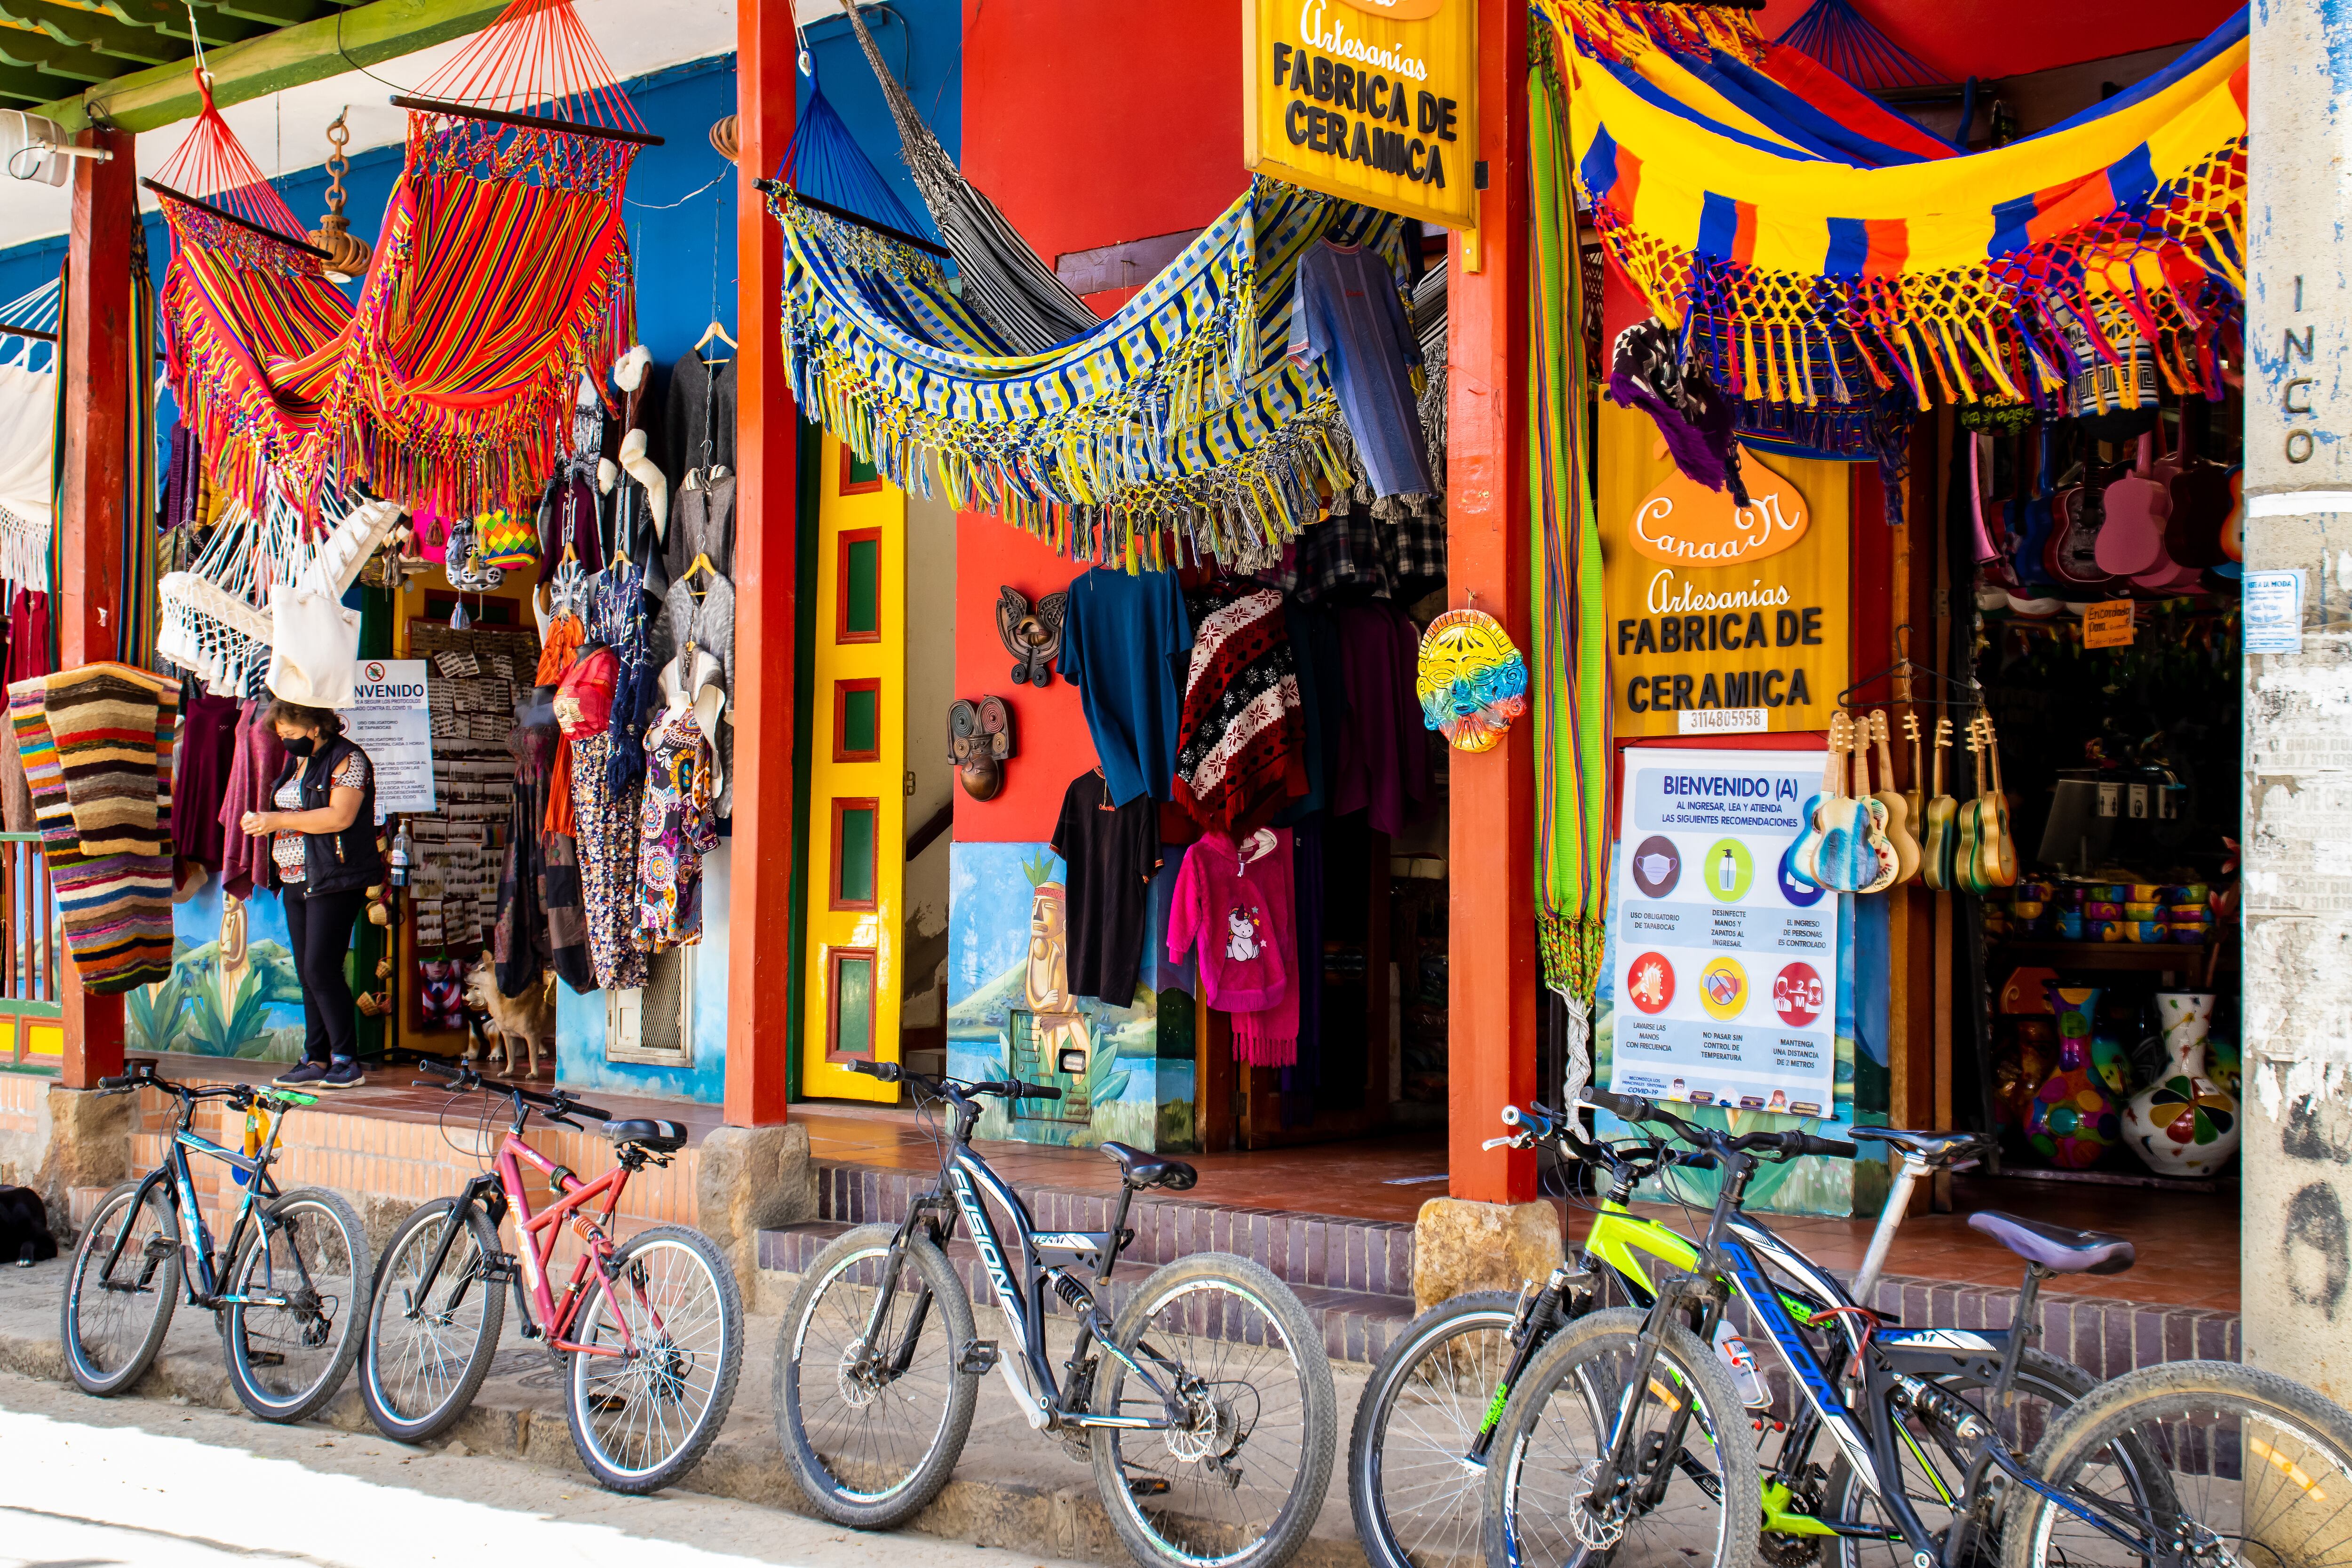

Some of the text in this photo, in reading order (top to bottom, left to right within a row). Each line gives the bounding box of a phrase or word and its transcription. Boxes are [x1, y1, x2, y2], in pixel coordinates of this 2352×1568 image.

[1274, 42, 1457, 142] FABRICA DE
[1286, 100, 1446, 188] CERAMICA
[1648, 569, 1790, 613] Artesanías
[1618, 607, 1822, 655] FABRICA DE
[355, 685, 424, 698] NVENIDO
[1628, 669, 1811, 713] CERAMICA
[1691, 710, 1761, 728] 3114805958
[1664, 775, 1797, 802] BIENVENIDO (A)
[1688, 802, 1726, 812] INGRESAR,
[1750, 804, 1782, 813] ATIENDA
[1662, 814, 1797, 827] LAS SIGUIENTES RECOMENDACIONES
[1787, 940, 1826, 948] CONTROLADO
[1797, 980, 1804, 991] 2
[1796, 996, 1804, 1007] M
[1640, 1043, 1672, 1051] FRECUENCIA
[1704, 1042, 1730, 1051] CONTROL
[1780, 1039, 1814, 1048] MANTENGA
[1701, 1051, 1742, 1061] TEMPERATURA
[1788, 1050, 1819, 1059] DISTANCIA
[1790, 1060, 1814, 1068] METROS
[949, 1167, 1013, 1296] FUSION
[1032, 1234, 1066, 1245] TEAM
[1719, 1242, 1847, 1415] FUSION
[1878, 1330, 1936, 1342] TEAM
[1101, 1341, 1141, 1374] FUSION
